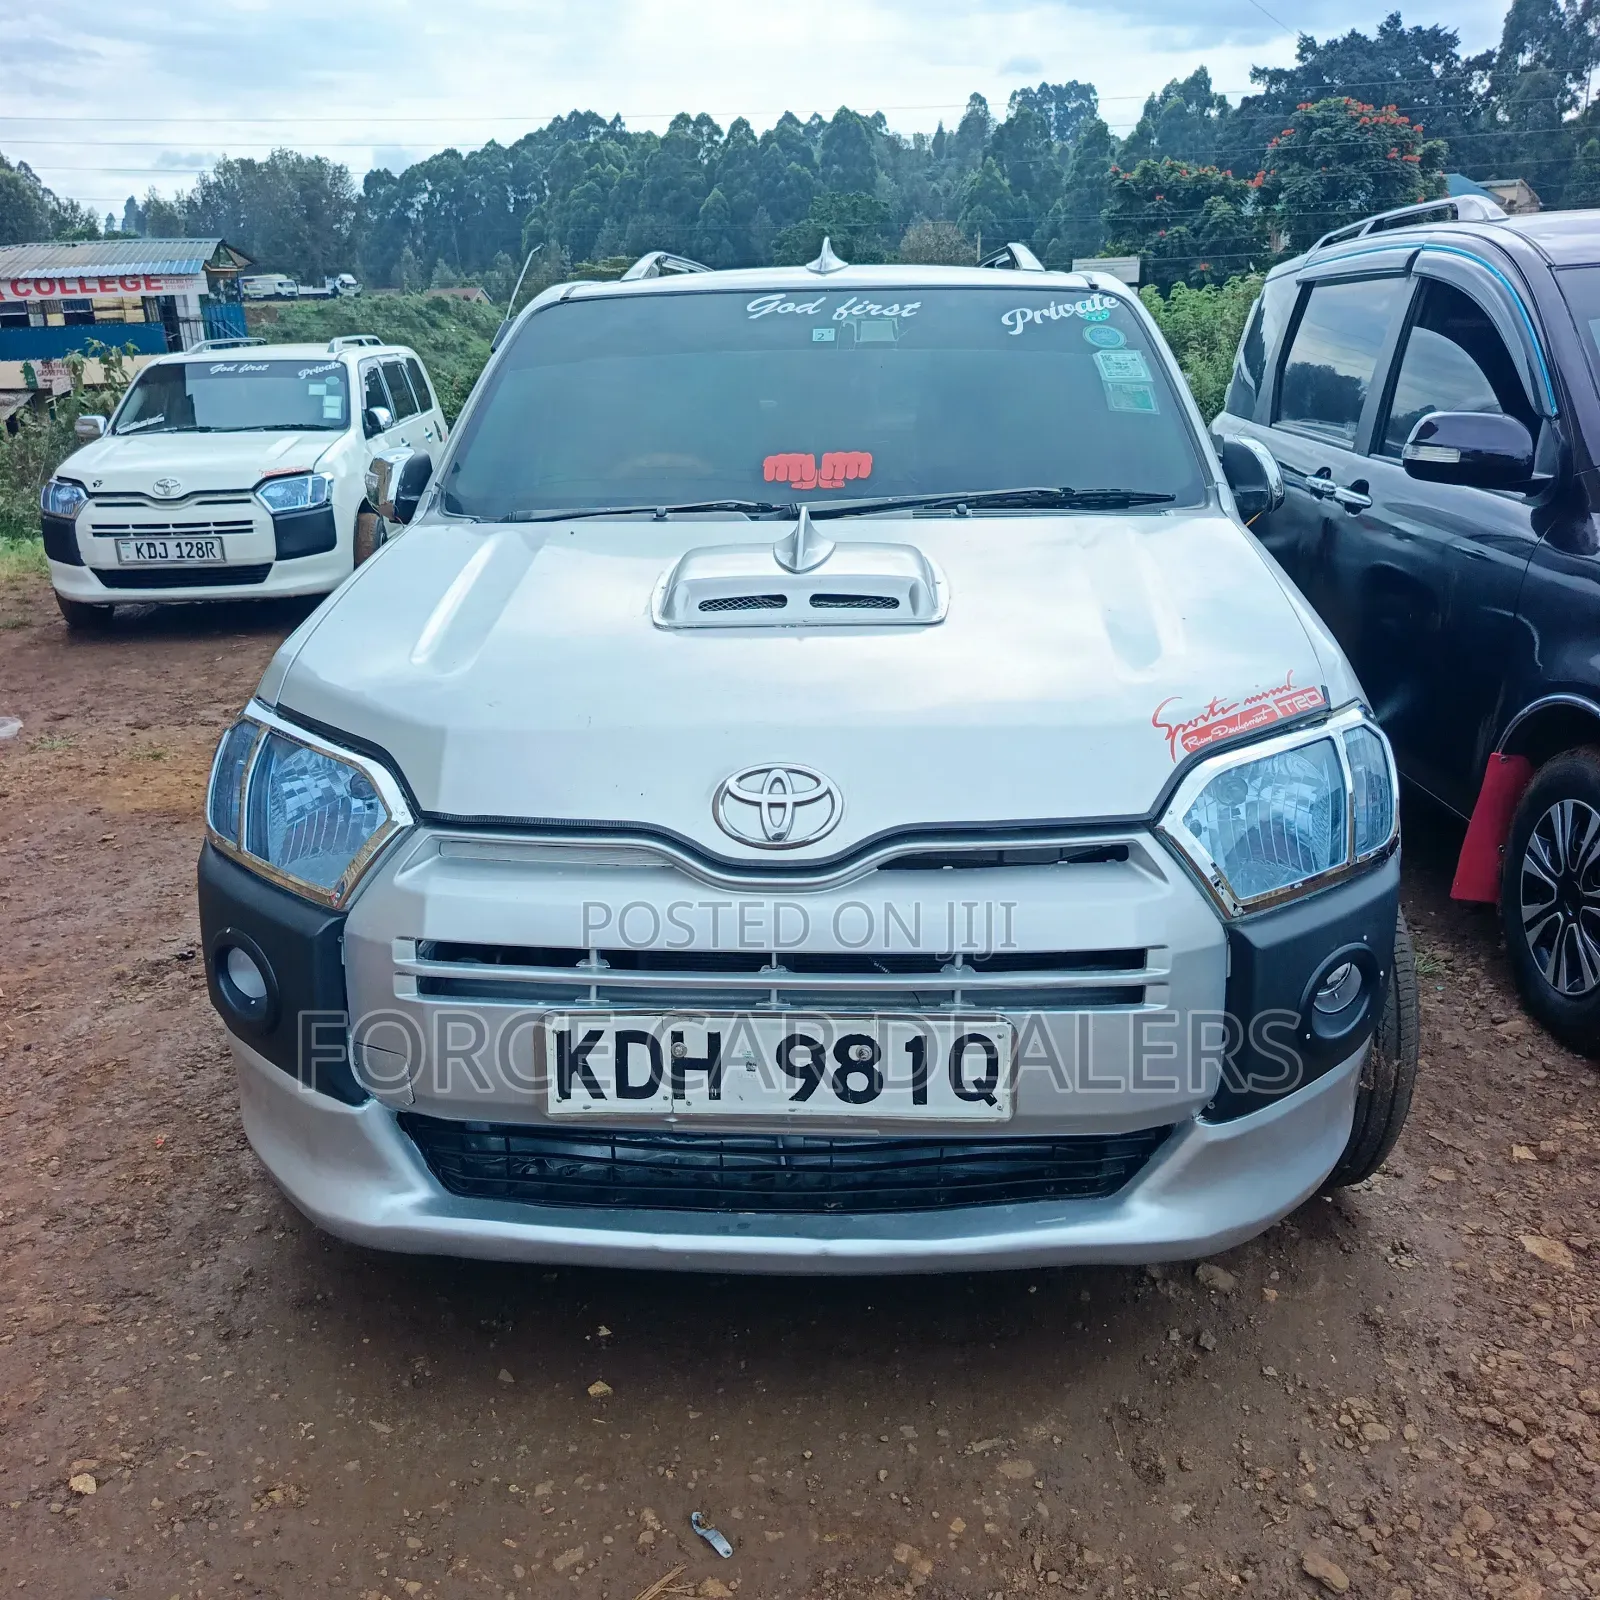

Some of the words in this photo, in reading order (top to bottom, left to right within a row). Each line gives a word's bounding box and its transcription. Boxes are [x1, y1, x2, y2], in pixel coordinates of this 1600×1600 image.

[10, 274, 163, 297] COLLEGE
[746, 293, 826, 319] God
[832, 297, 922, 320] first
[1001, 293, 1120, 335] Private
[209, 363, 238, 375] God
[238, 364, 269, 373] first
[298, 361, 341, 380] Private
[135, 542, 169, 559] KDJ
[175, 541, 217, 559] 128R
[1278, 691, 1322, 714] TRD
[1152, 696, 1241, 763] Sports
[1243, 669, 1297, 706] mind
[556, 1029, 722, 1102] KDH
[775, 1031, 999, 1107] 981Q
